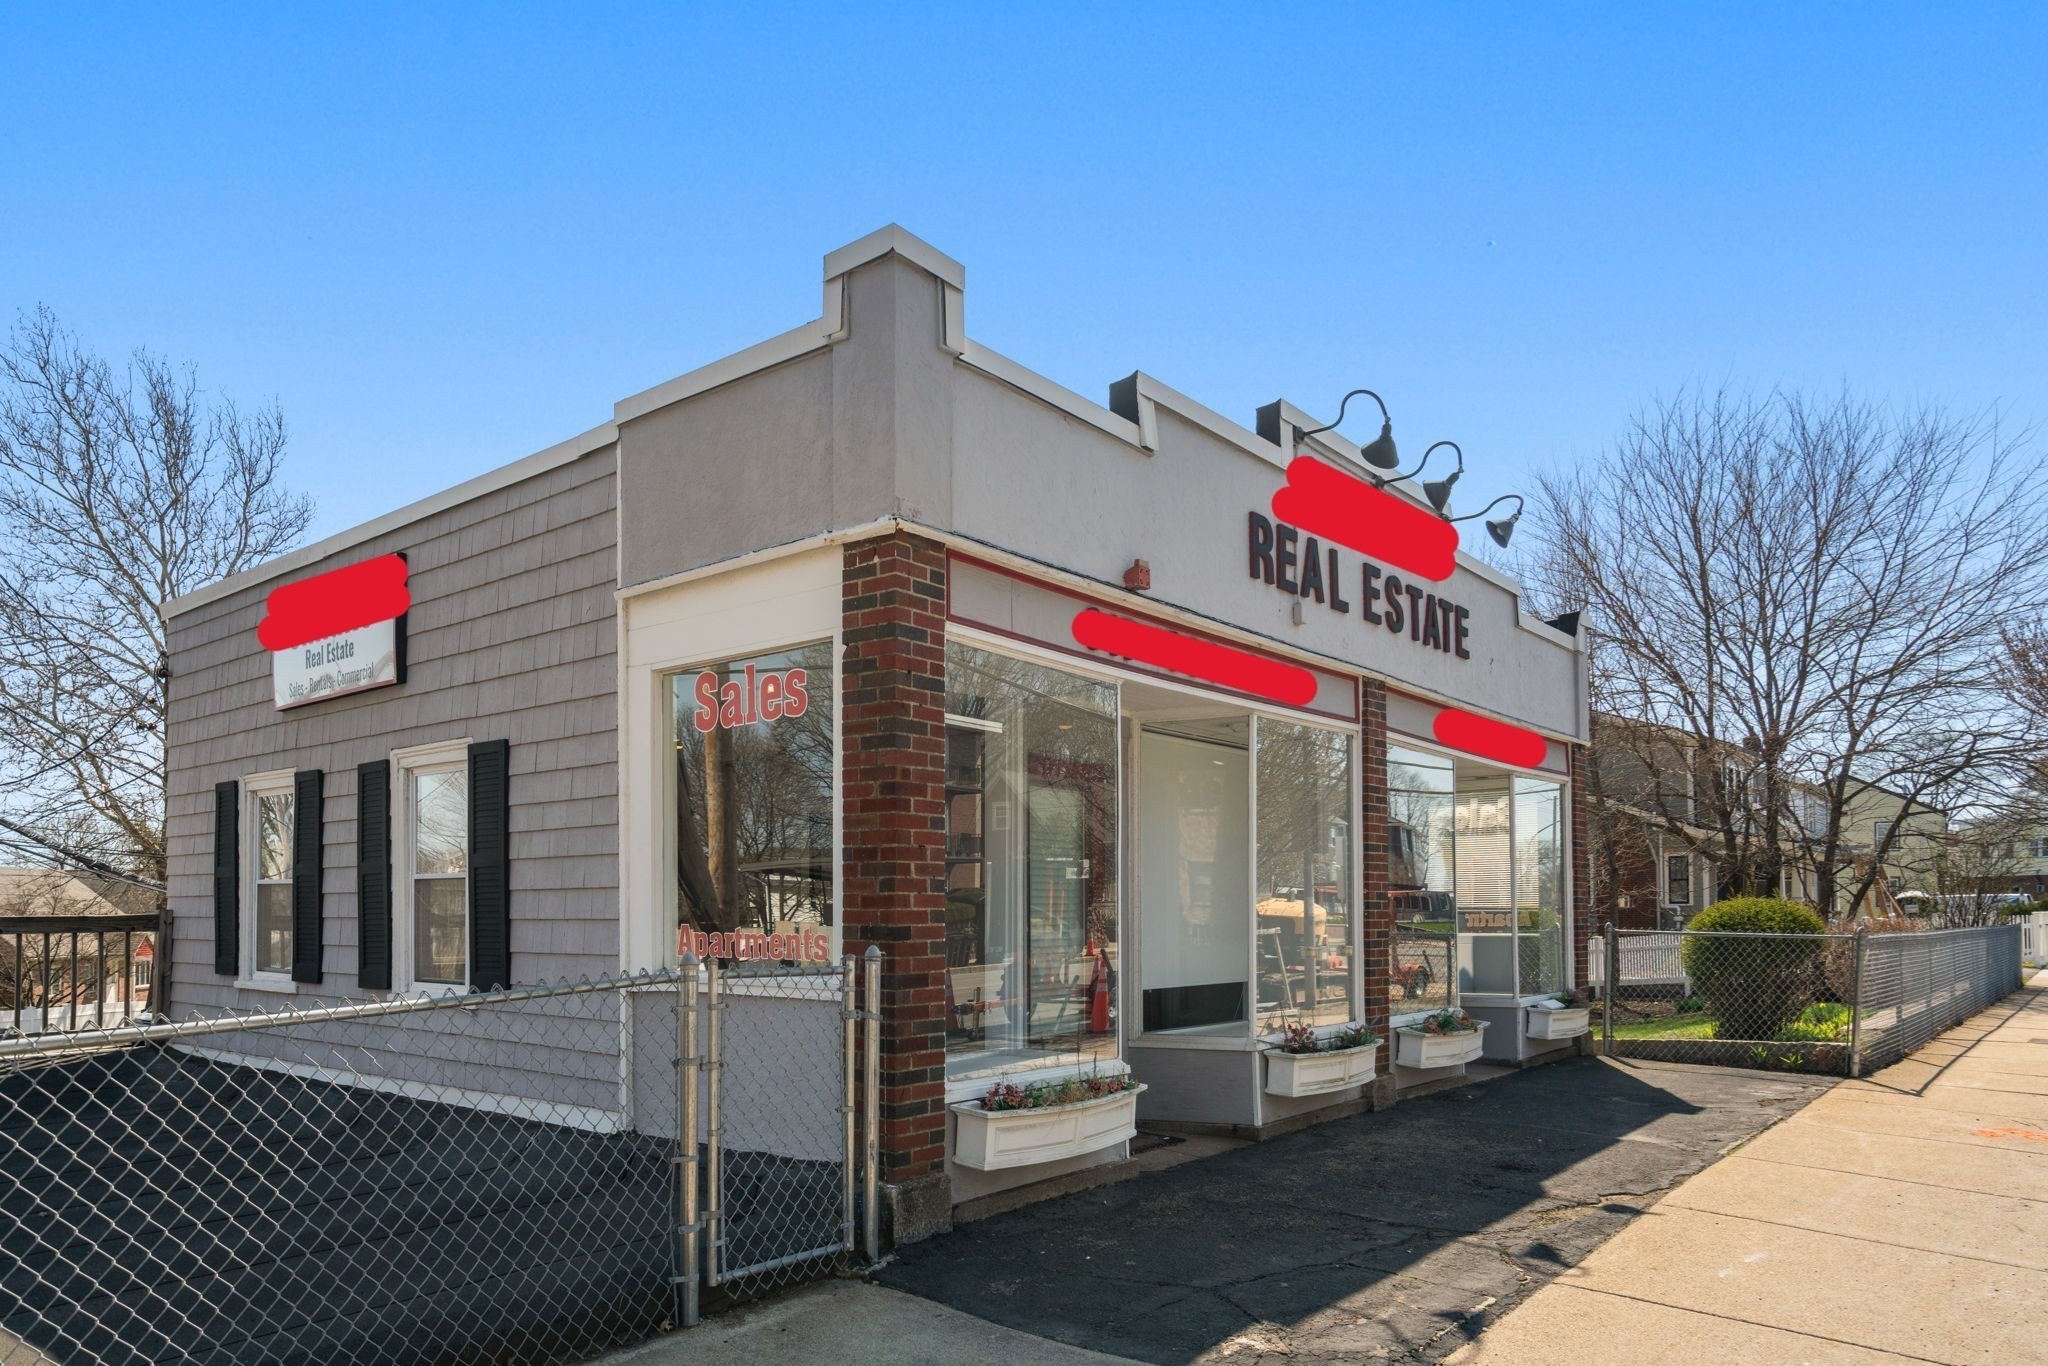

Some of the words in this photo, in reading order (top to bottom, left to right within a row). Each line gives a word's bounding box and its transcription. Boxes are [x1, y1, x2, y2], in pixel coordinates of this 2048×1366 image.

[1248, 510, 1349, 614] REAL
[1362, 562, 1470, 660] ESTATE
[305, 645, 324, 670] Real
[326, 639, 354, 664] Estate
[288, 681, 304, 698] Sales
[337, 661, 374, 687] Commercial
[693, 663, 808, 733] Sales
[677, 923, 830, 962] Apartments
